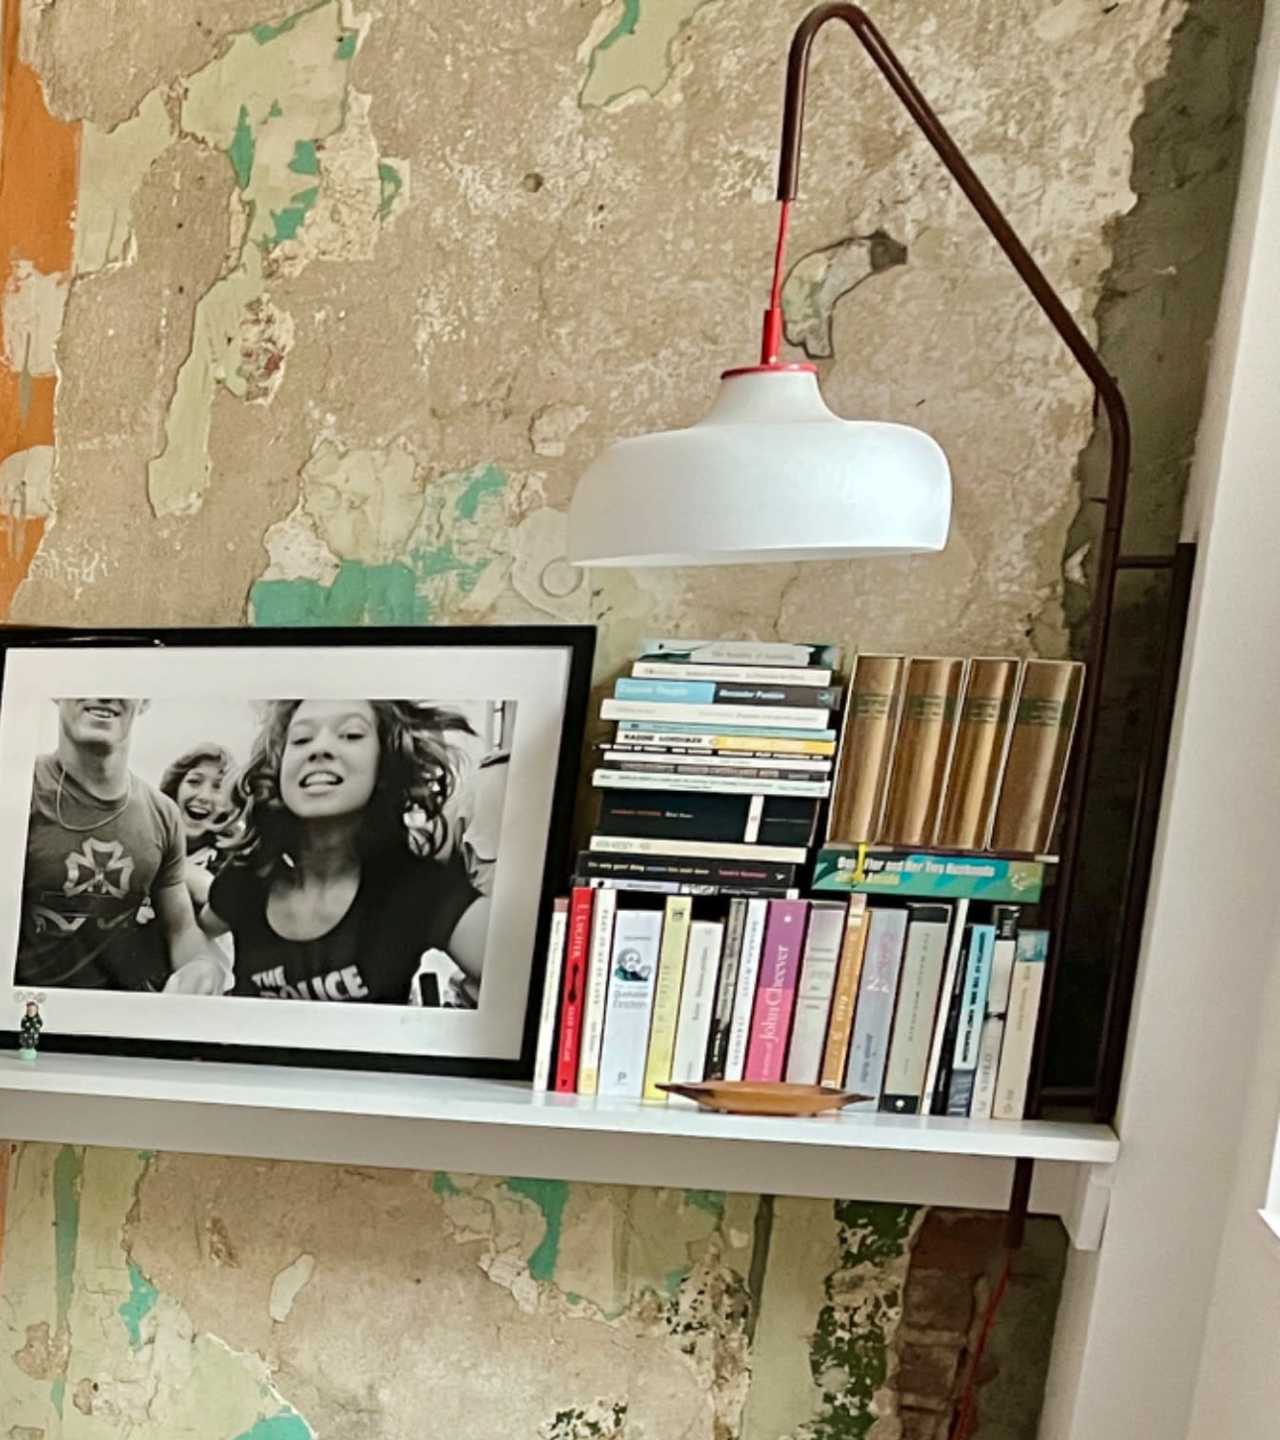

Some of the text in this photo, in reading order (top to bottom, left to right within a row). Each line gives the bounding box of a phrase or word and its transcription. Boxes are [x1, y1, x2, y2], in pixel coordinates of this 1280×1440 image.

[251, 965, 285, 987] THE
[766, 945, 789, 1006] Cheever
[758, 1007, 780, 1042] John
